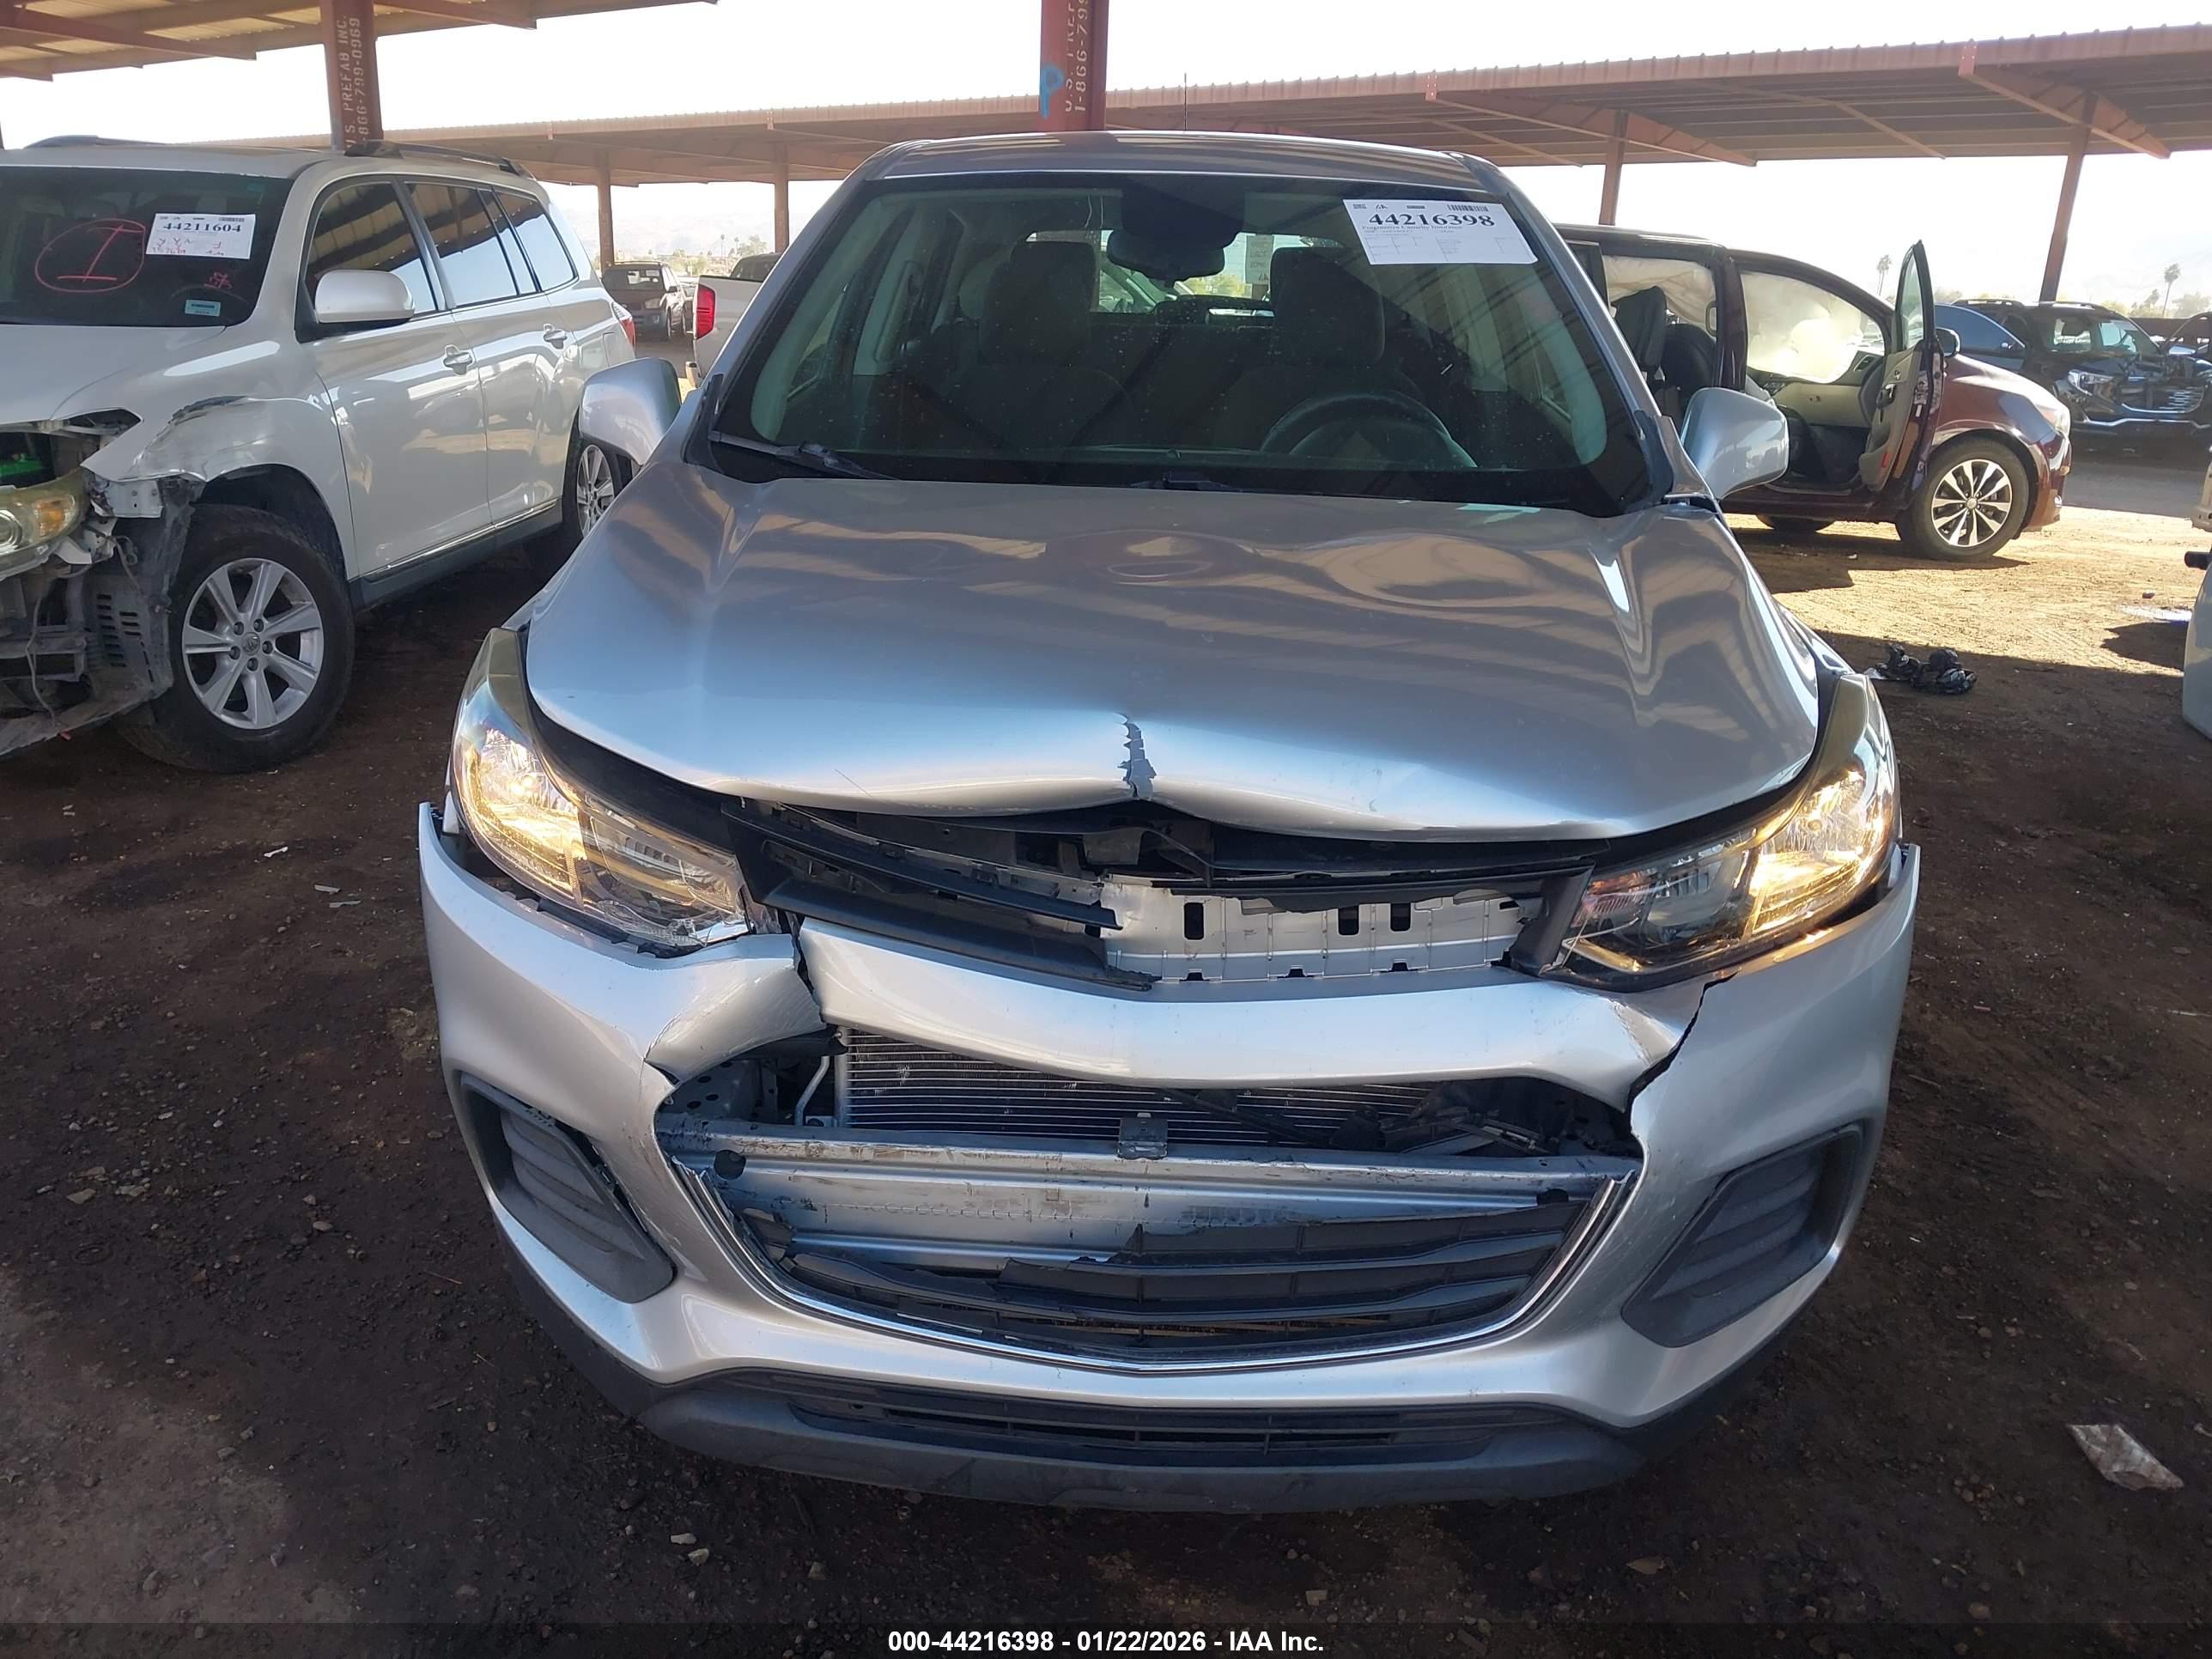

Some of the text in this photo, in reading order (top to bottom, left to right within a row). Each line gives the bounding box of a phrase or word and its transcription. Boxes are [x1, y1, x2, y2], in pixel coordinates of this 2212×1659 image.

[336, 15, 349, 44] INC.
[338, 52, 354, 111] PREFAB
[162, 222, 241, 233] 44211604
[1369, 214, 1495, 227] 44216398
